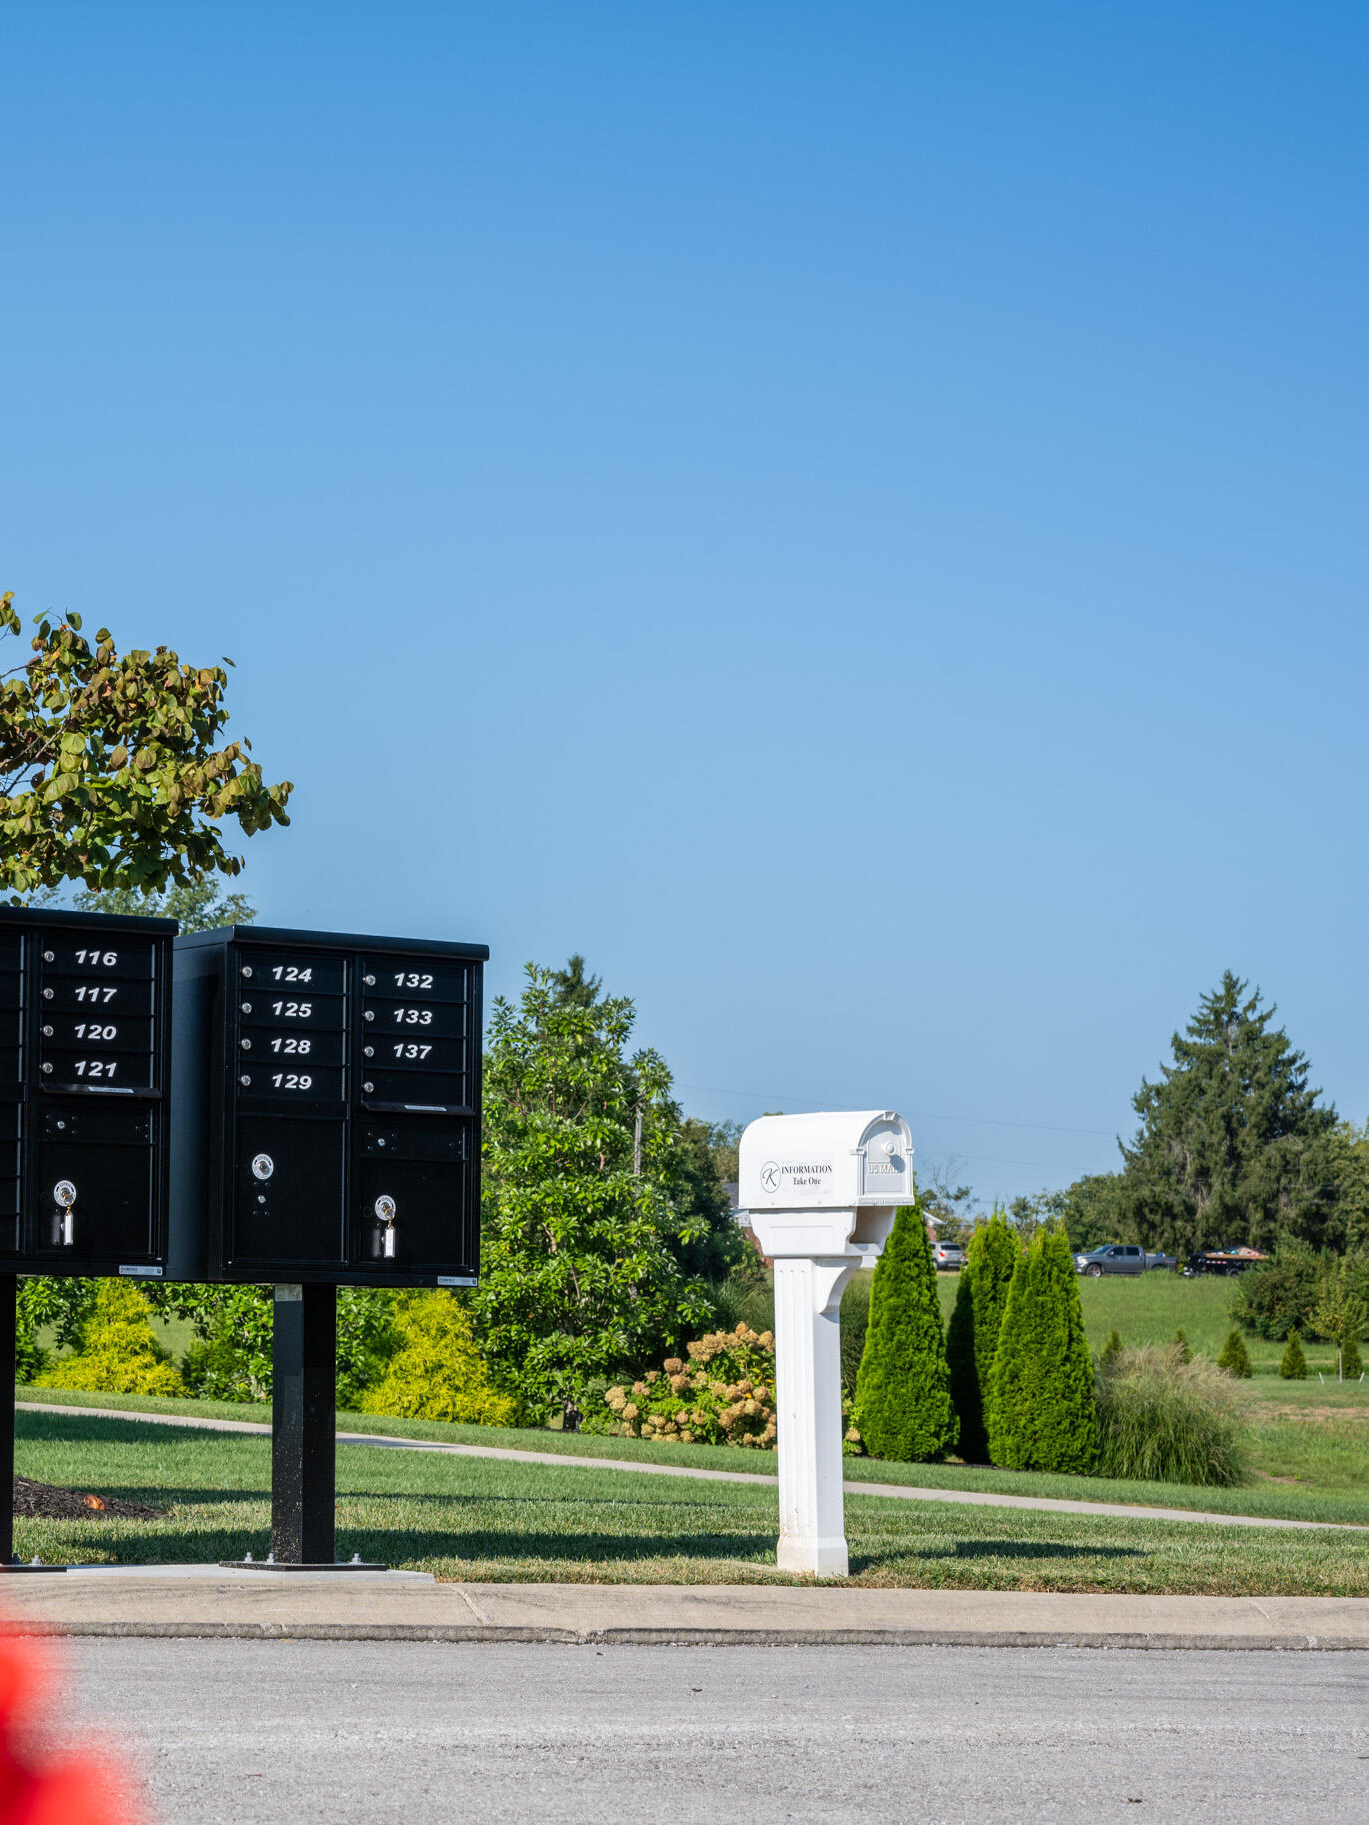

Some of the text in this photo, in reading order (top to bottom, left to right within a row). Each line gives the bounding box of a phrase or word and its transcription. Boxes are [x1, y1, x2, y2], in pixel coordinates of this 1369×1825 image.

[75, 949, 118, 966] 116
[272, 965, 312, 982] 124
[394, 972, 433, 989] 132
[74, 986, 117, 1003] 117
[272, 1001, 312, 1018] 125
[393, 1008, 433, 1025] 133
[74, 1023, 117, 1040] 120
[270, 1038, 311, 1054] 128
[393, 1043, 432, 1060] 137
[74, 1060, 117, 1077] 121
[272, 1073, 312, 1090] 129
[781, 1164, 833, 1175] INFORMATION
[793, 1176, 822, 1186] Take One
